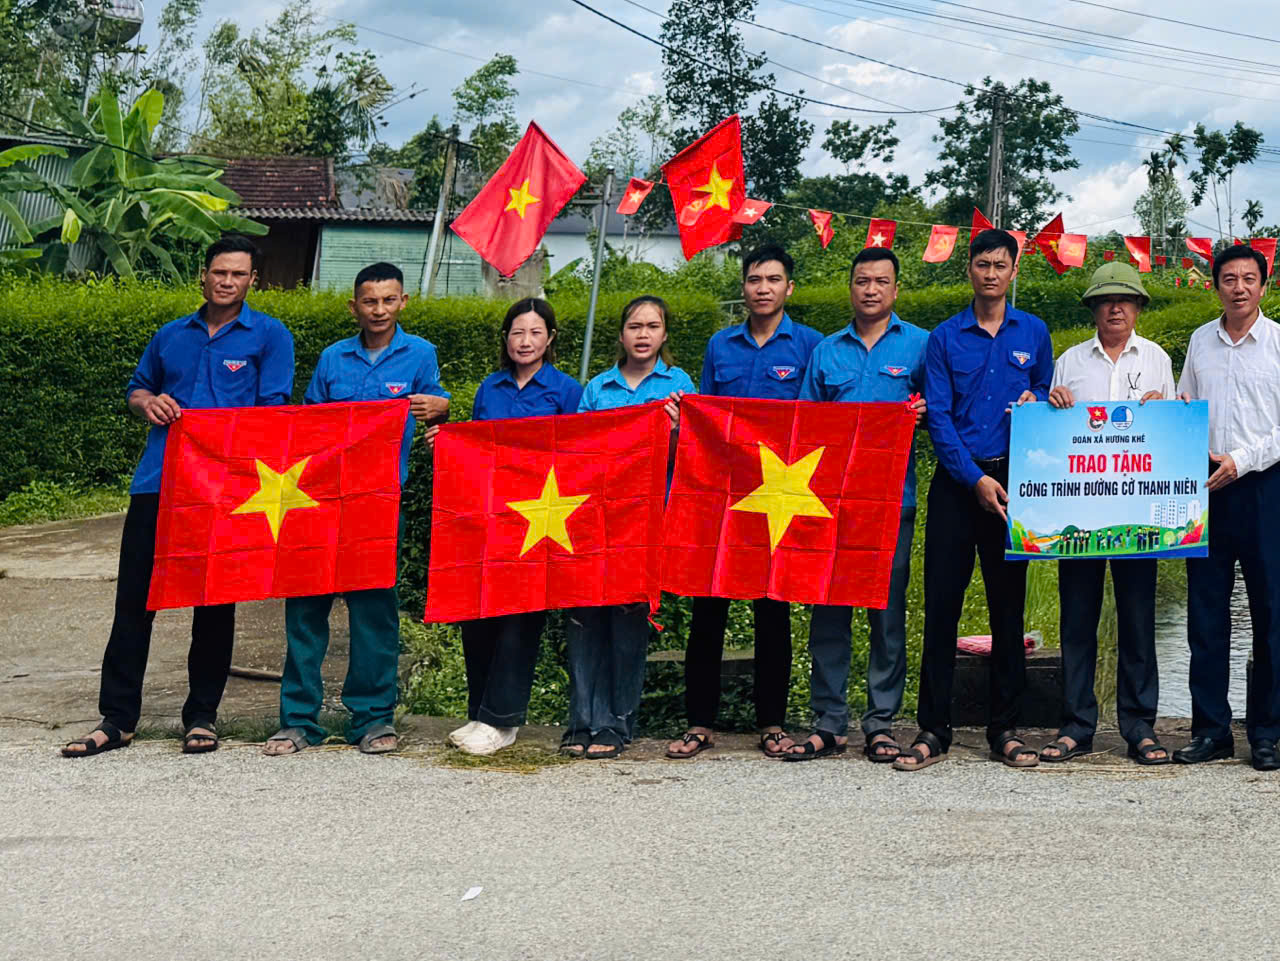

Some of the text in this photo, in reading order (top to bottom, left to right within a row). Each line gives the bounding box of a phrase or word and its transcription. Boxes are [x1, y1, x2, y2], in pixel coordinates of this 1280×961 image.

[1067, 449, 1152, 477] TRAO TẶNG
[1019, 477, 1198, 497] CÔNG TRÌNH ĐƯỜNG CỜ THANH NIÊN
